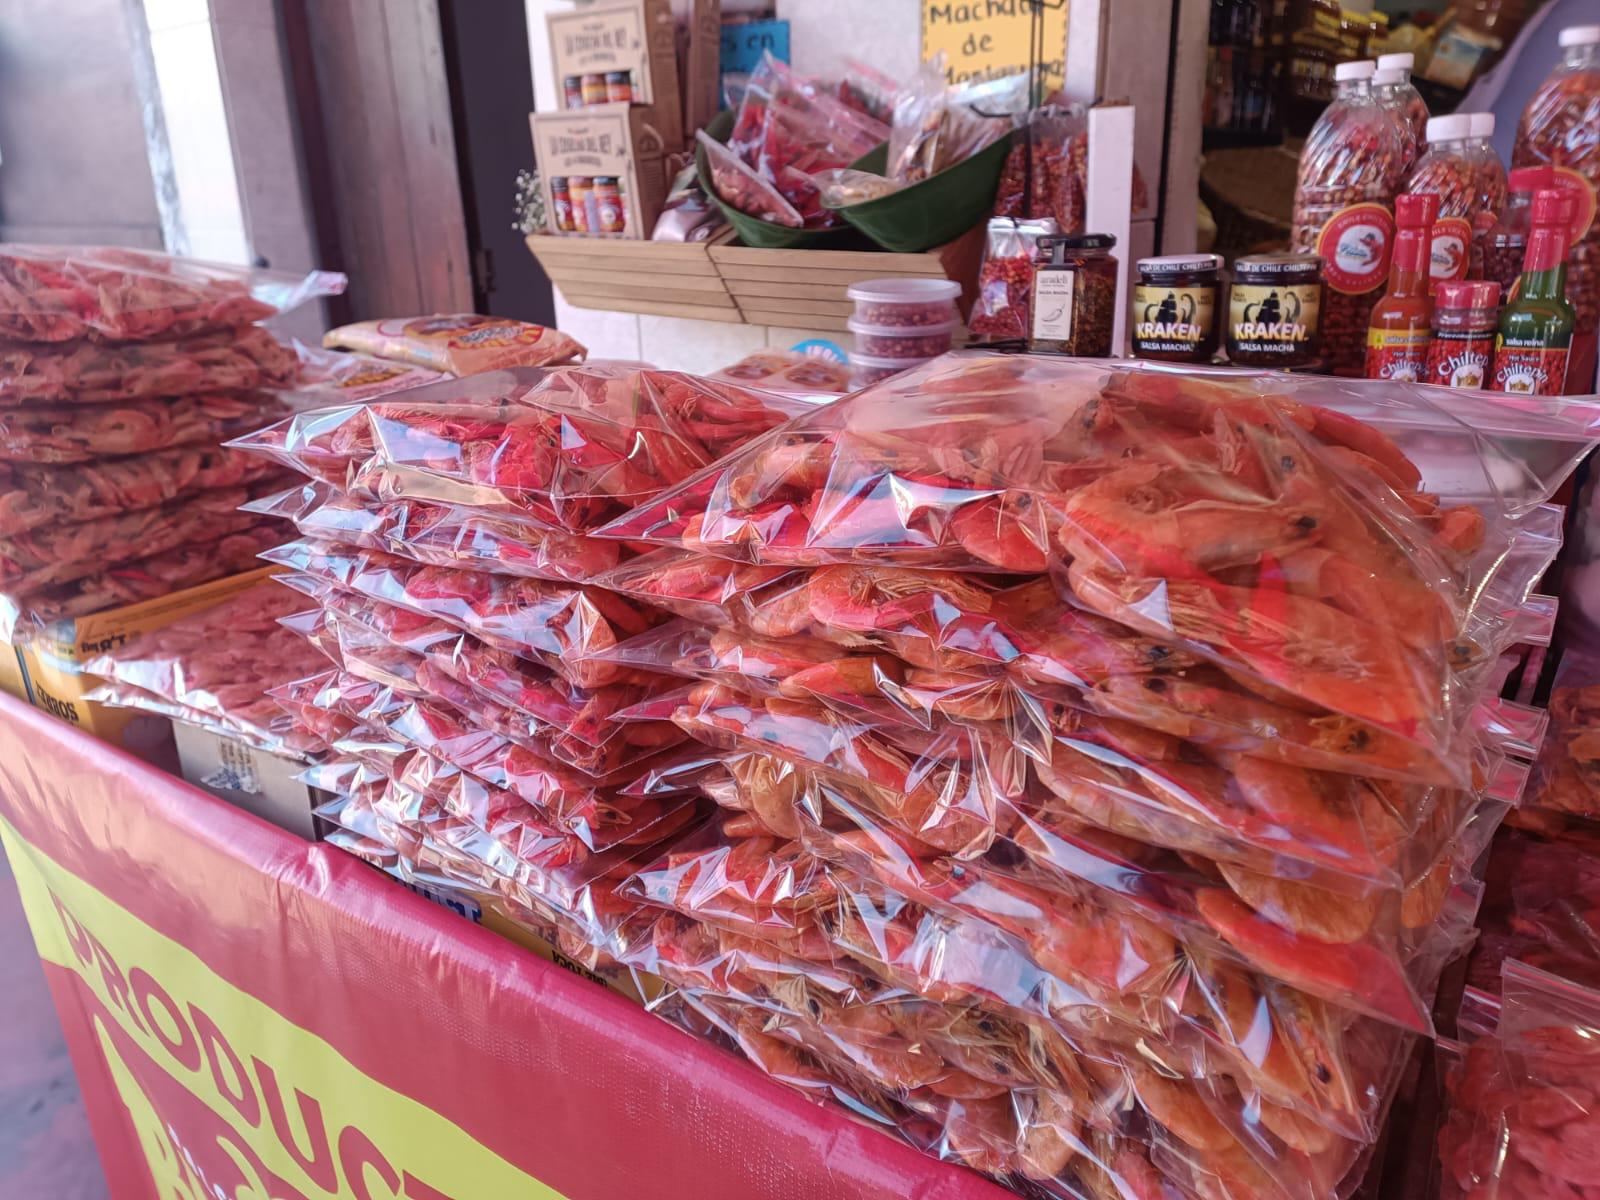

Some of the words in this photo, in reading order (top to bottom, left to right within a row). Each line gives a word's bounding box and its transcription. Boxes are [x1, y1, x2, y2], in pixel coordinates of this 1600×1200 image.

[962, 33, 993, 56] de
[1261, 264, 1281, 272] CHILE
[1136, 322, 1202, 341] KRAKEN
[1234, 322, 1307, 341] KRAKEN
[1140, 341, 1161, 350] SALSA
[1161, 342, 1192, 351] MACHA
[1239, 342, 1262, 351] SALSA
[1263, 343, 1296, 352] MACHA
[1506, 338, 1523, 346] salsa
[48, 885, 453, 1200] PRODUC
